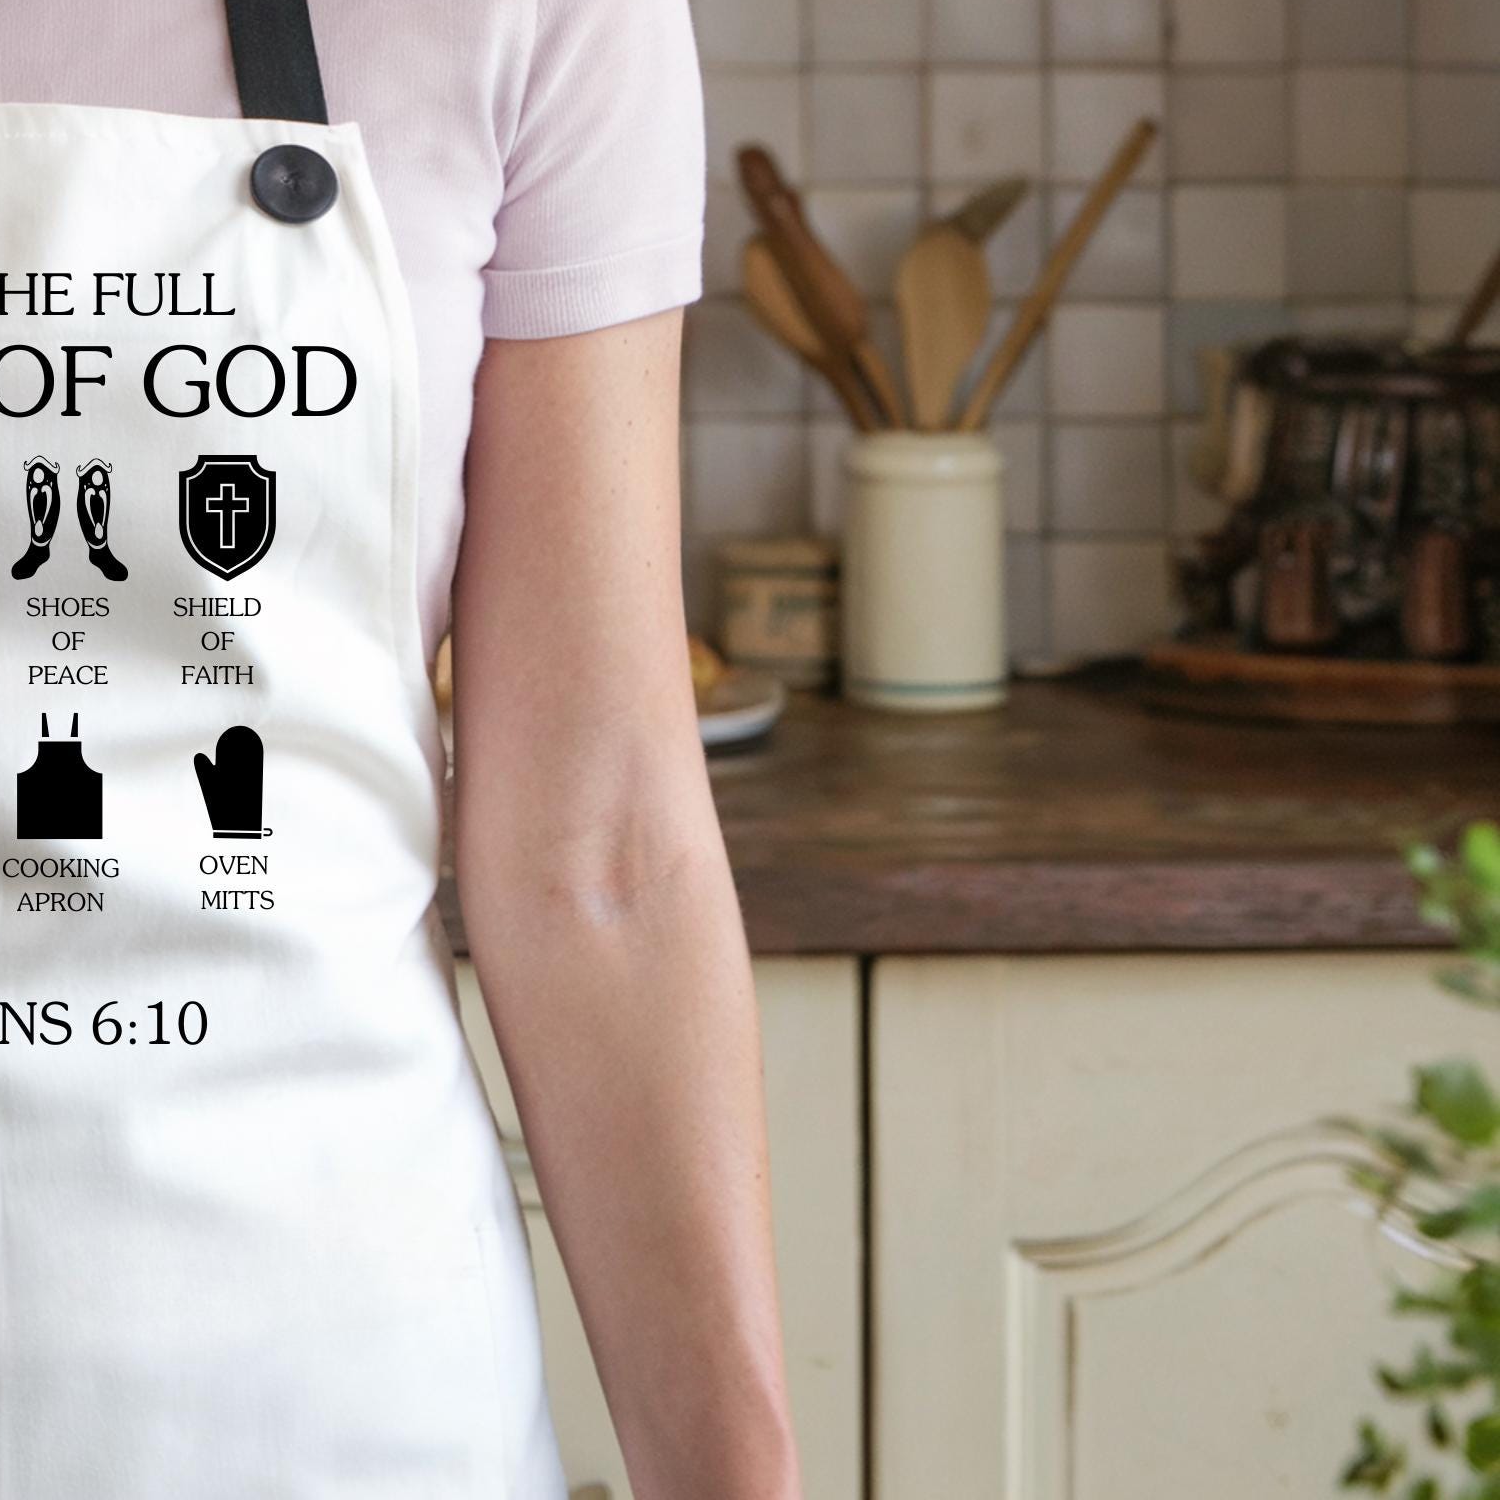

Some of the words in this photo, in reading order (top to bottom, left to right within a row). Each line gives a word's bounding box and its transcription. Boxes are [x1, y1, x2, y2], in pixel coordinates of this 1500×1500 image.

[92, 272, 236, 317] FULL
[143, 344, 358, 419] GOD
[26, 596, 110, 618] SHOES
[172, 596, 262, 618] SHIELD
[51, 631, 86, 651] OF
[200, 631, 235, 652] OF
[28, 664, 109, 685] PEACE
[181, 665, 254, 685] FAITH
[2, 857, 119, 879] COOKING
[199, 855, 269, 876] OVEN
[16, 891, 105, 912] APRON
[200, 890, 275, 910] MITTS
[92, 1000, 208, 1046] 6:10
